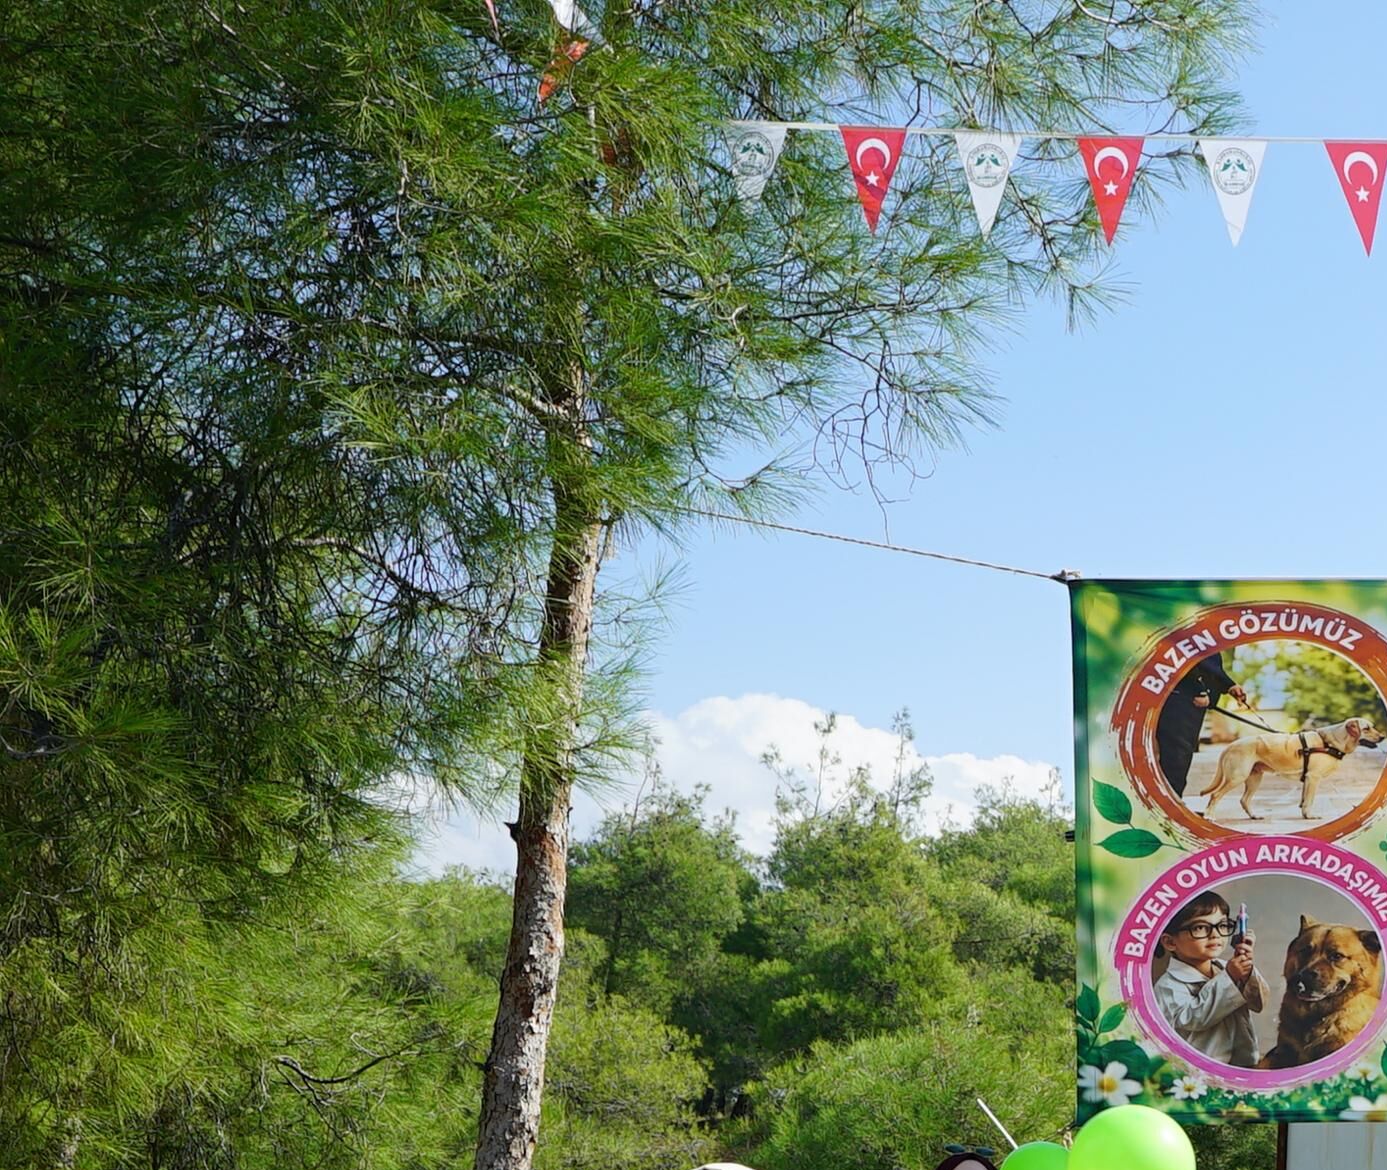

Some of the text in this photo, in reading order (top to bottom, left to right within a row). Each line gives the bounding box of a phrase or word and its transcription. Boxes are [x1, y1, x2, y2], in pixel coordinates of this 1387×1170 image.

[1141, 609, 1364, 697] BAZEN GÖZÜMÜZ
[1122, 877, 1175, 961] BAZEN
[1175, 844, 1250, 893] OYUN
